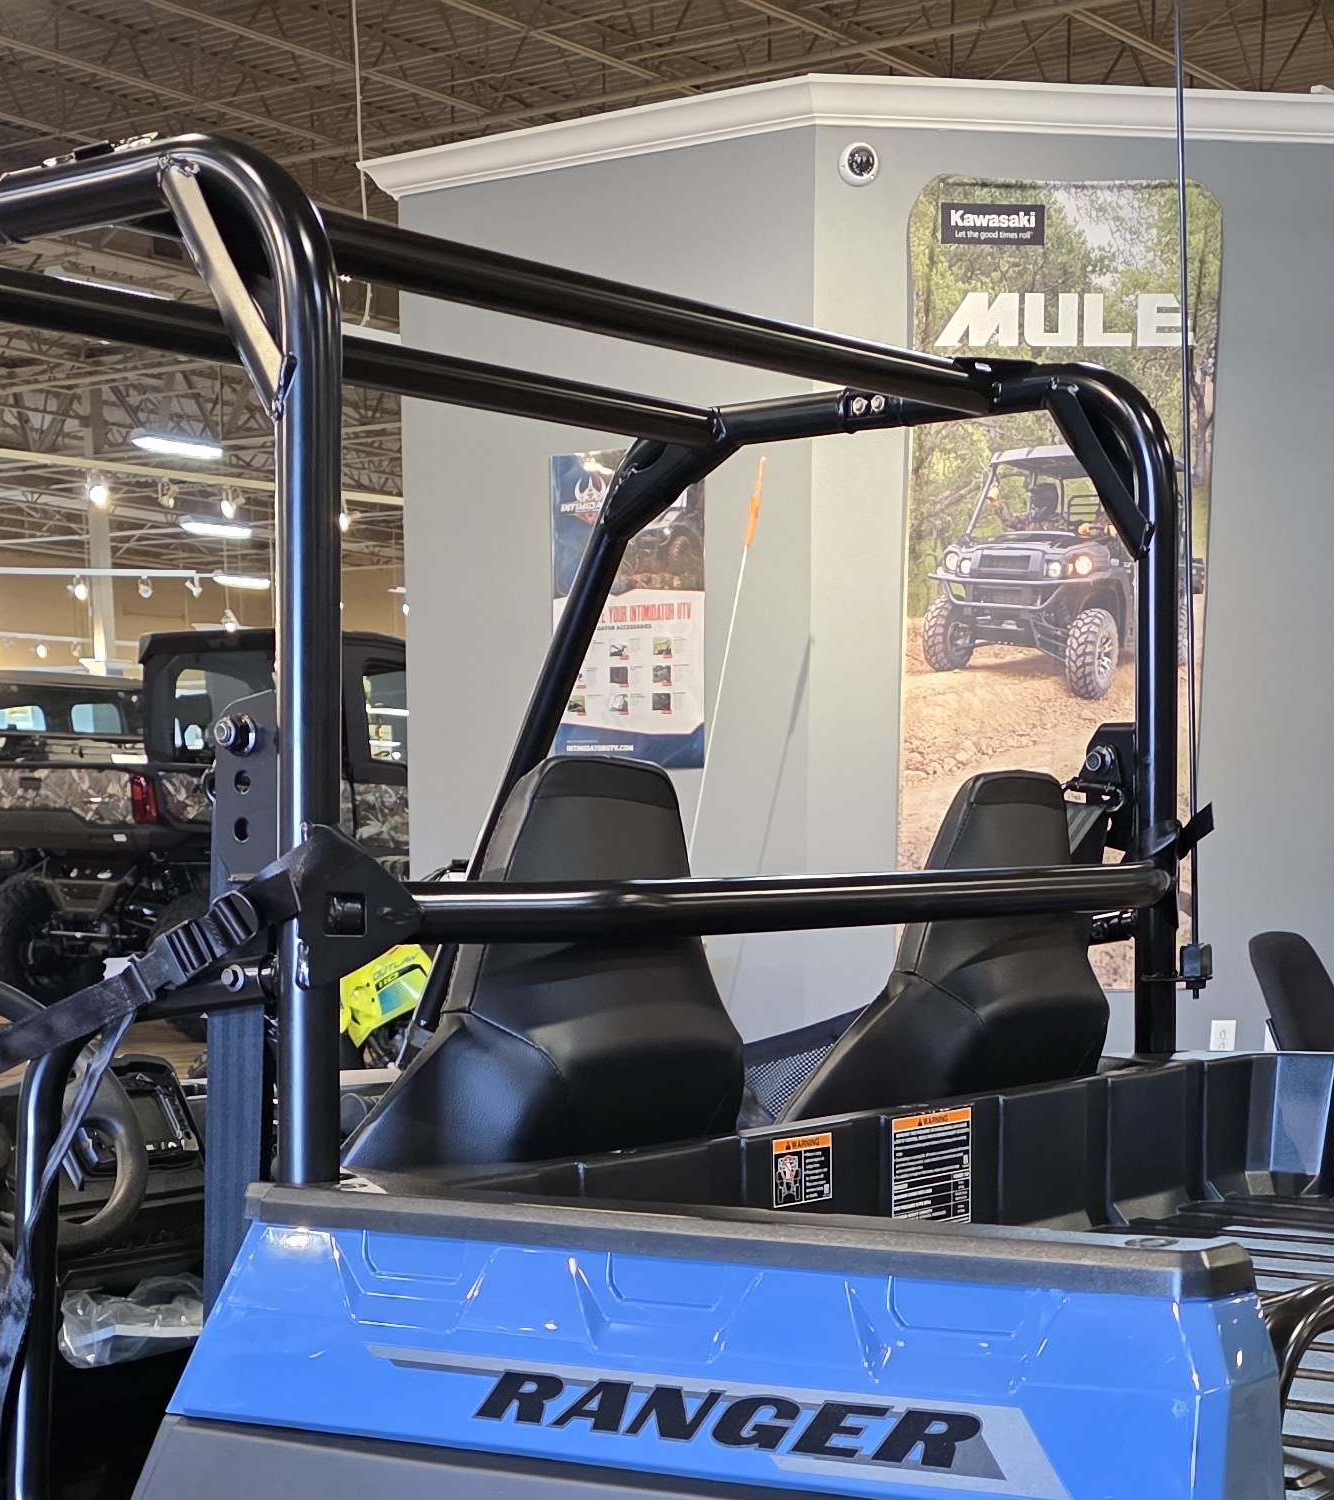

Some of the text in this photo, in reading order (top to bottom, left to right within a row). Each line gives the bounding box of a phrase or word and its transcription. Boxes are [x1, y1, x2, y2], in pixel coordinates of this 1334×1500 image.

[950, 209, 1036, 228] Kawasaki
[954, 229, 966, 238] Let
[966, 230, 979, 238] the
[980, 230, 998, 240] good
[999, 230, 1018, 239] times
[934, 291, 1195, 347] MULE
[609, 602, 692, 623] YOUR INTIMIDATOR UTV
[923, 1114, 948, 1125] WARNING
[791, 1137, 820, 1149] WARNING
[476, 1369, 983, 1471] RANGER
